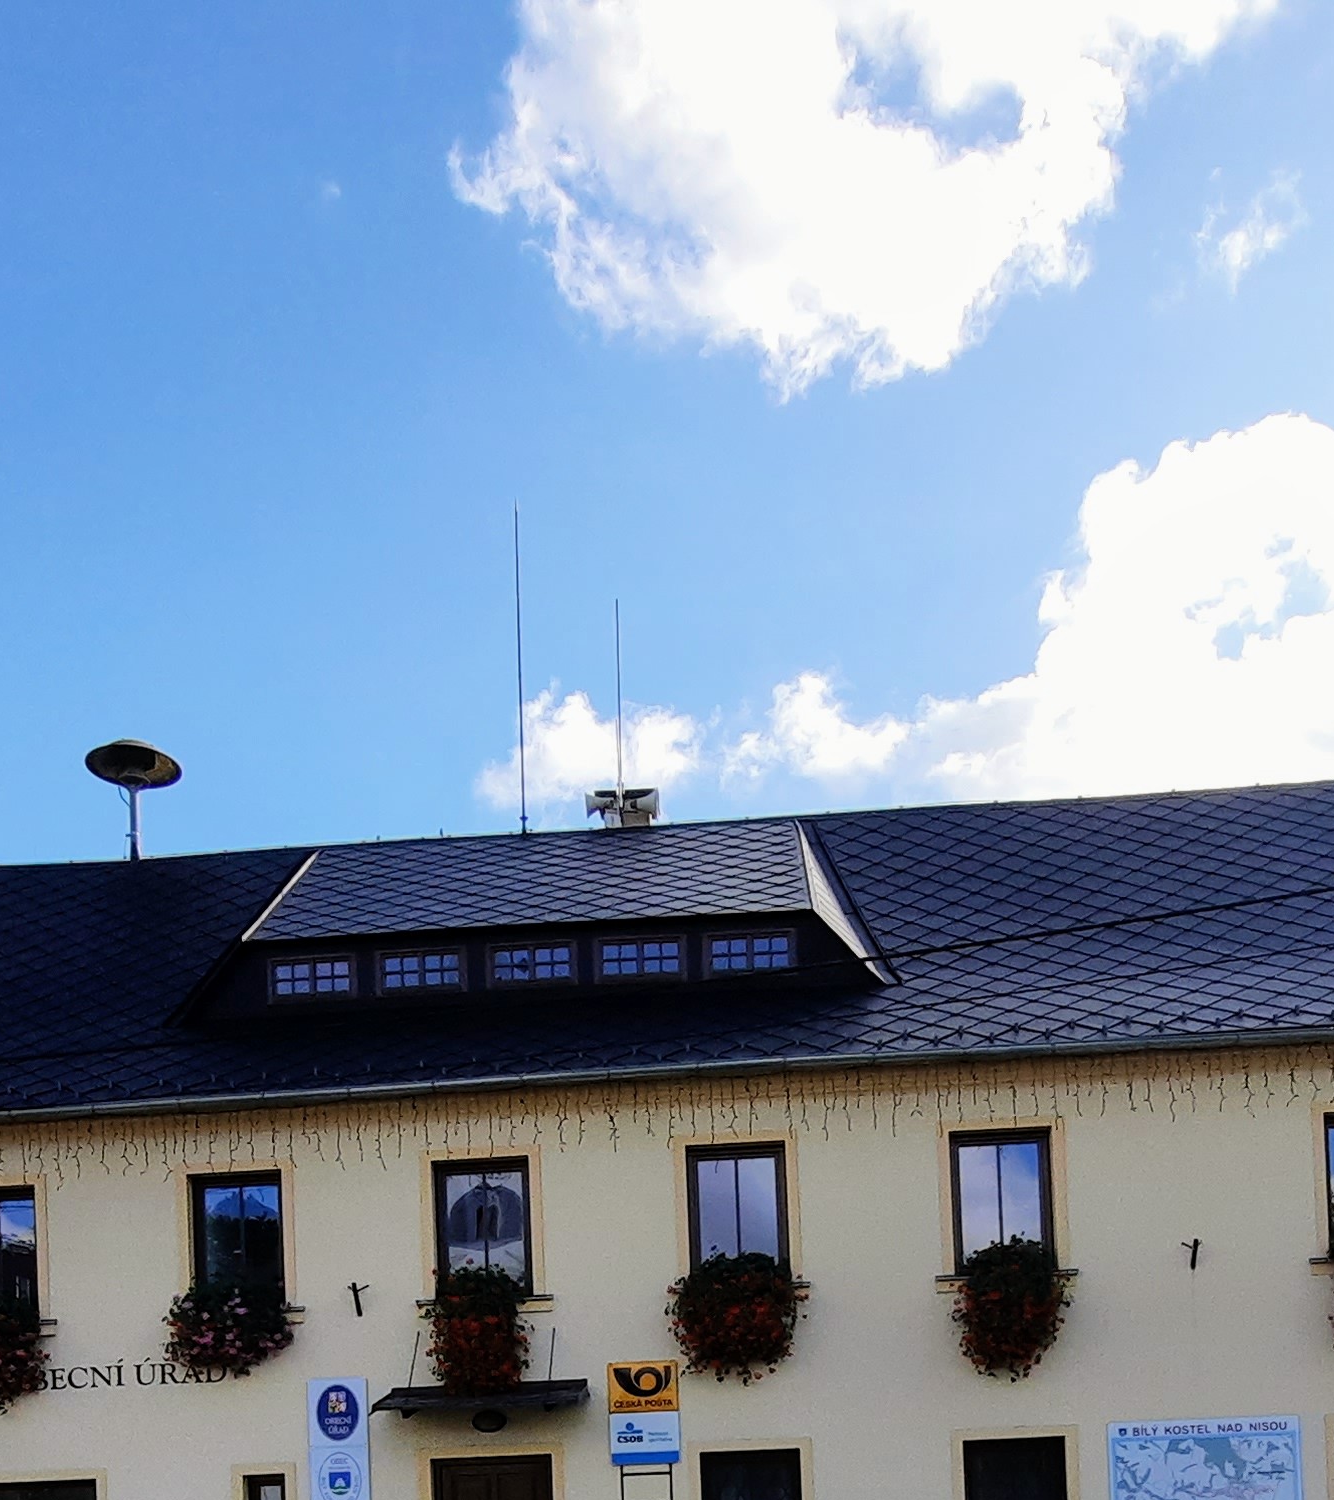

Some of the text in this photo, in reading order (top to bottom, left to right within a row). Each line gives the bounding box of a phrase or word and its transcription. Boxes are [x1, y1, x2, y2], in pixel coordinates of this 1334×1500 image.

[33, 1358, 124, 1391] BECNÍ
[614, 1398, 673, 1409] ČESKÁ POŠTA
[1132, 1421, 1288, 1437] BÍLÝ KOSTEL NAD NISOU
